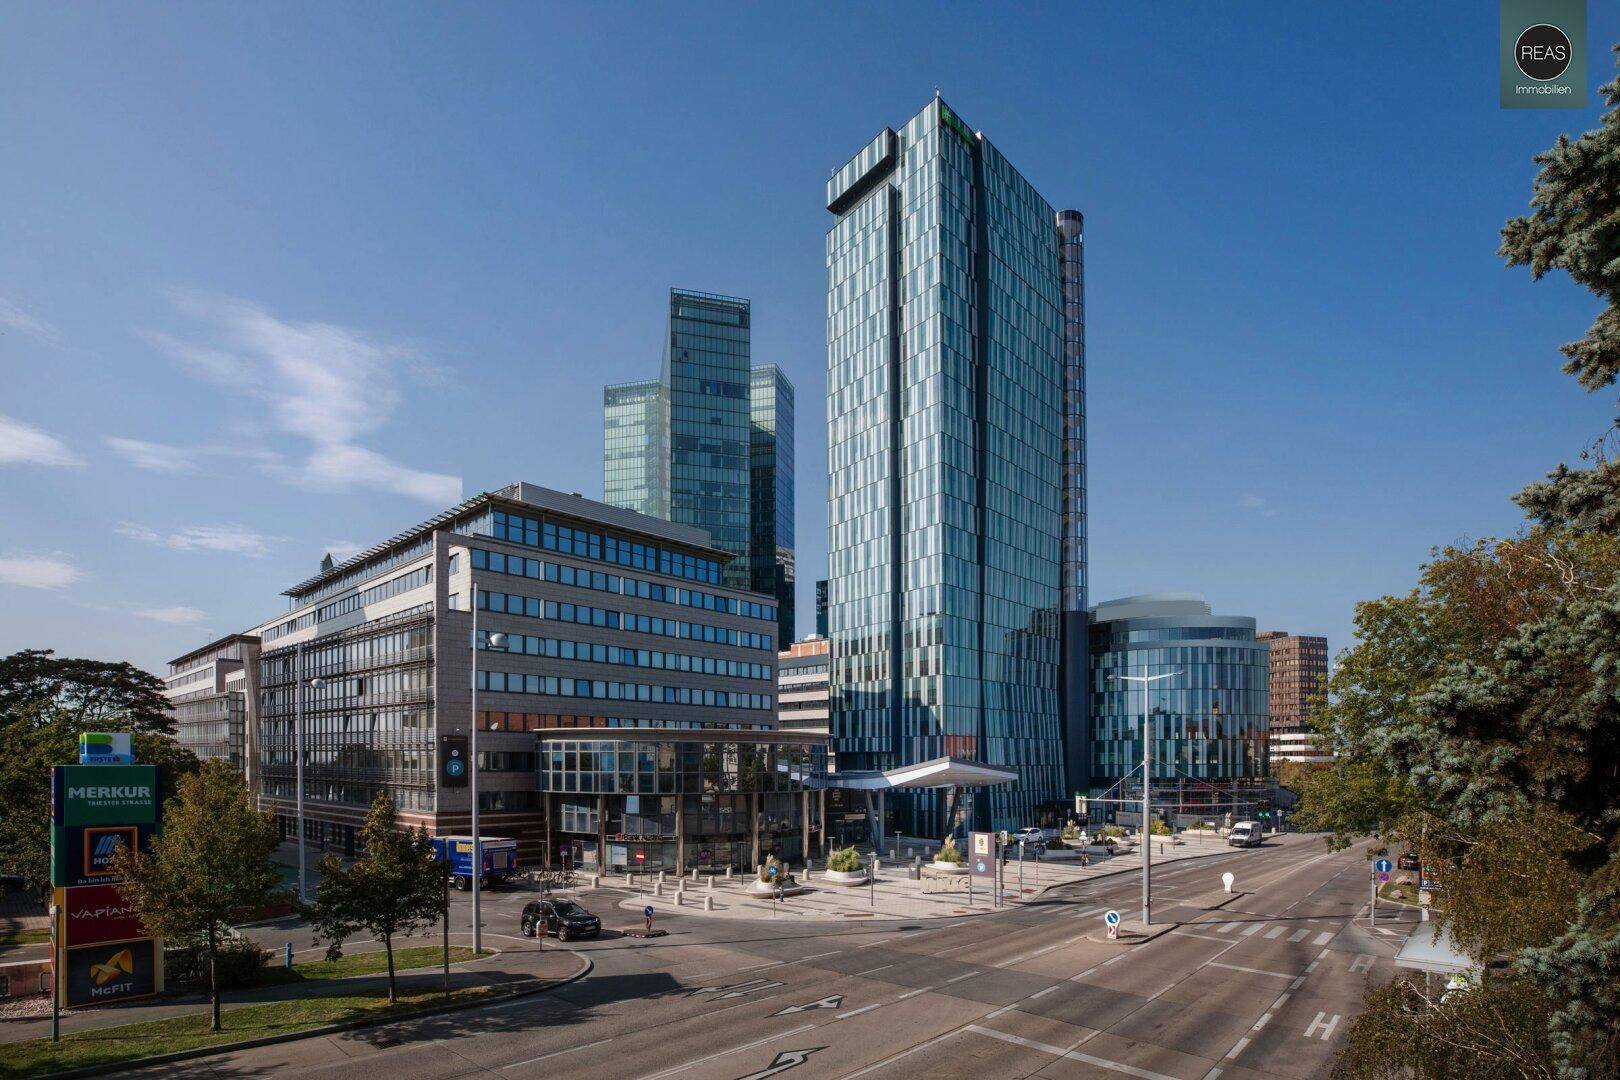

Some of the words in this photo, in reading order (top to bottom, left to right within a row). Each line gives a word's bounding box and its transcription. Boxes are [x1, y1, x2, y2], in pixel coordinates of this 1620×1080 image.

[68, 786, 151, 799] MERKUR
[71, 906, 133, 919] VAPIAN
[1303, 1011, 1341, 1041] H
